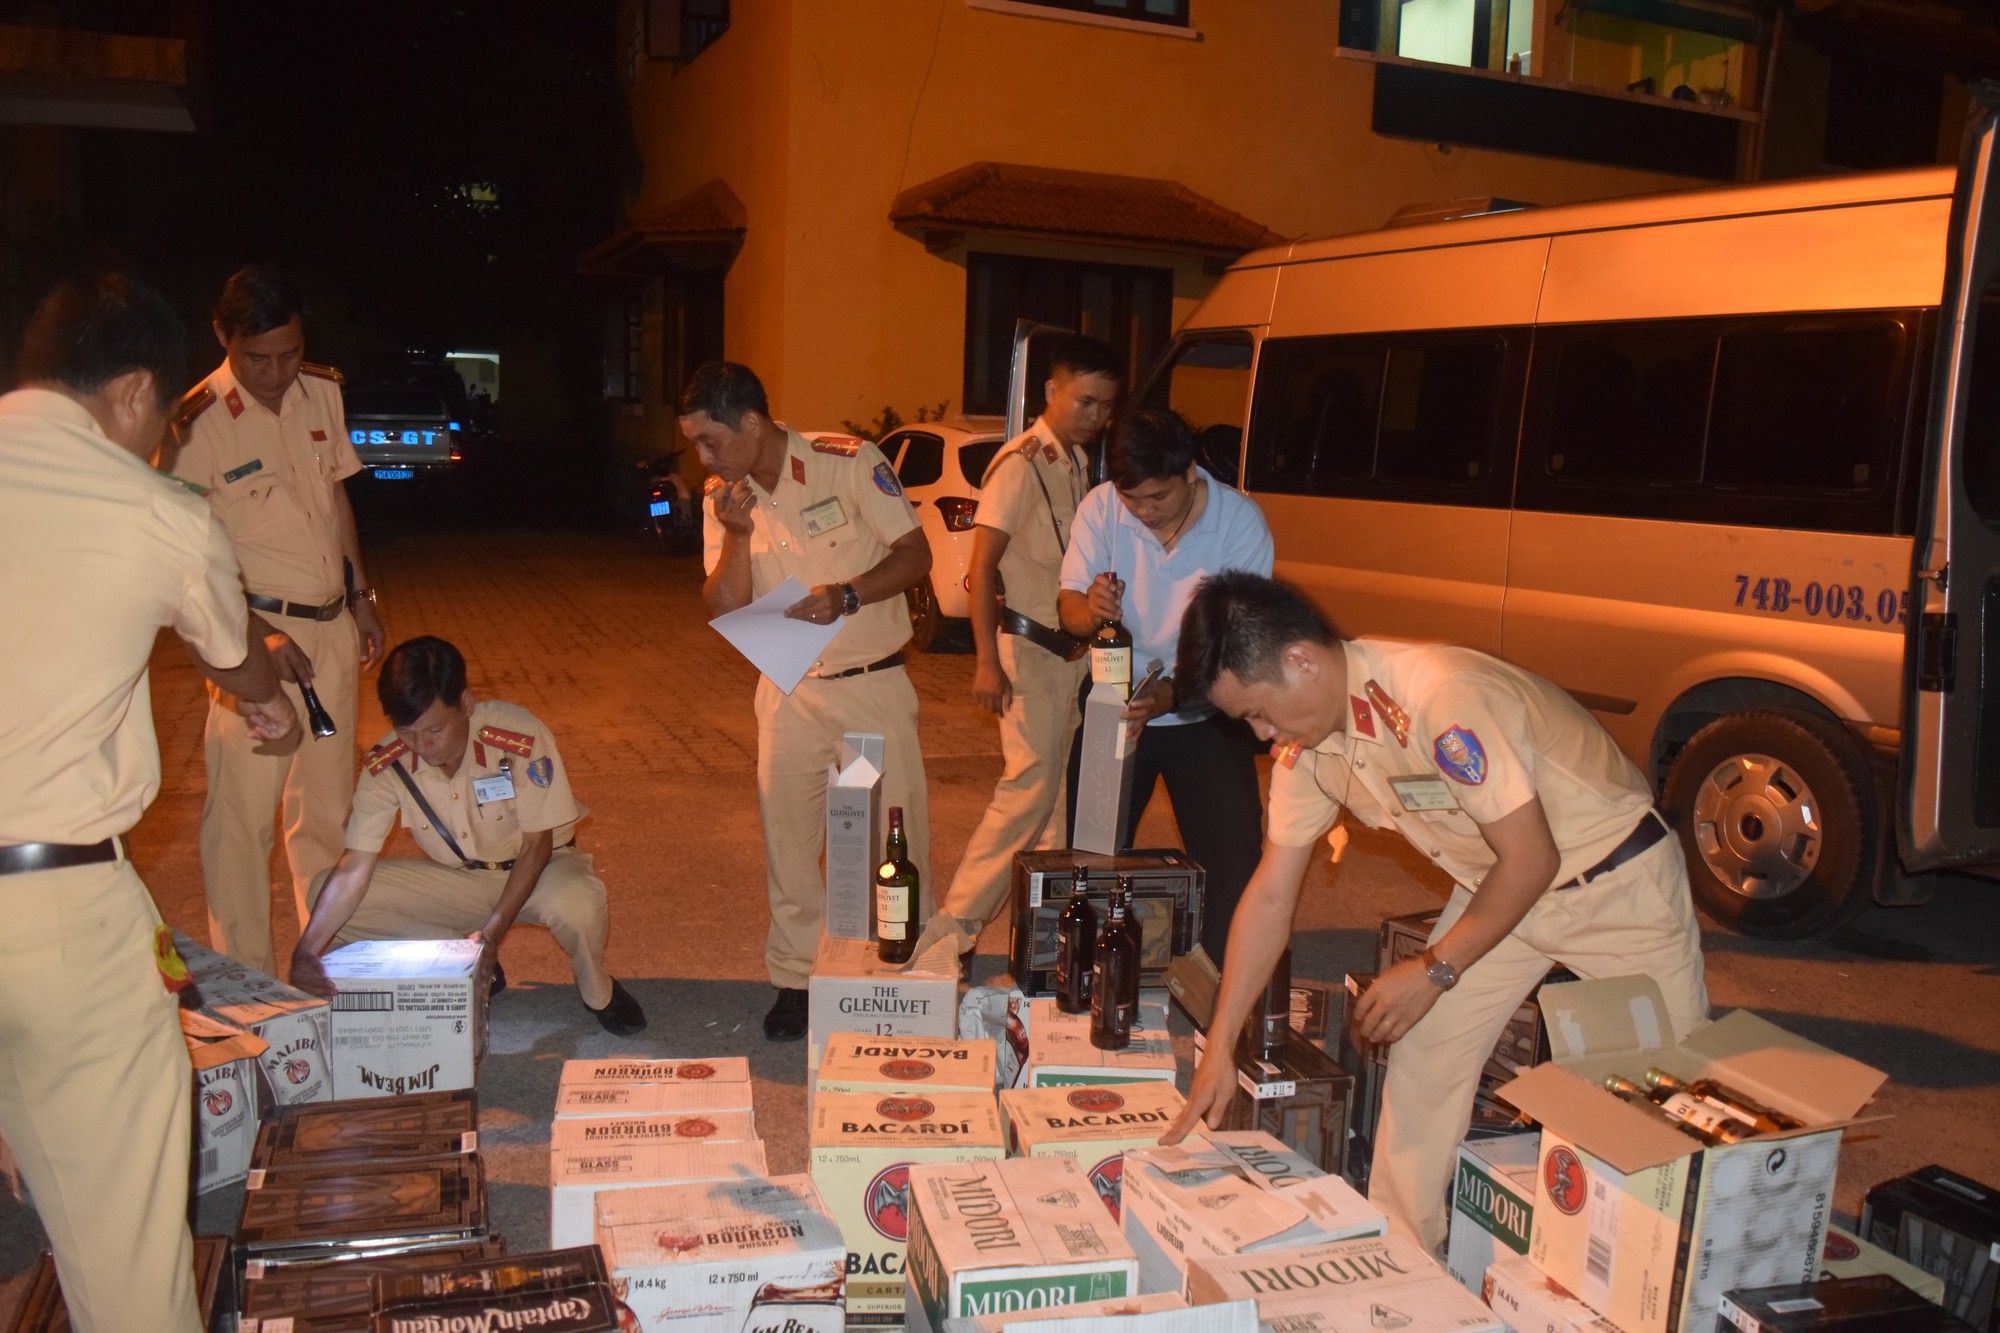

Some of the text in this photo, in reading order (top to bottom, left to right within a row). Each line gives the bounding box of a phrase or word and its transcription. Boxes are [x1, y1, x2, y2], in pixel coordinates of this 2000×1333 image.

[350, 430, 436, 445] CS GT
[830, 809, 865, 818] GLENLIVET
[877, 894, 900, 902] ENLIVET
[872, 986, 898, 998] THE
[839, 998, 930, 1016] GLENLIVET
[874, 1023, 893, 1037] 12
[266, 1038, 320, 1074] MALIBU
[595, 1067, 673, 1076] BOURBON
[360, 1064, 440, 1096] JIM BEAM
[585, 1124, 671, 1136] BOURBON
[818, 1155, 828, 1163] 12
[835, 1155, 861, 1163] 750mL
[1459, 1167, 1528, 1241] MIDORI
[945, 1174, 1021, 1253] MIDORI
[706, 1225, 805, 1245] BOURBON
[1156, 1220, 1184, 1254] LIQUEUR
[737, 1240, 780, 1250] WHISKEY
[708, 1271, 759, 1285] 12 x 750 ml
[1239, 1250, 1409, 1294] MIDORI
[635, 1277, 666, 1290] 14.4 kg
[965, 1285, 1078, 1317] MIDORI
[500, 1297, 592, 1331] Captain
